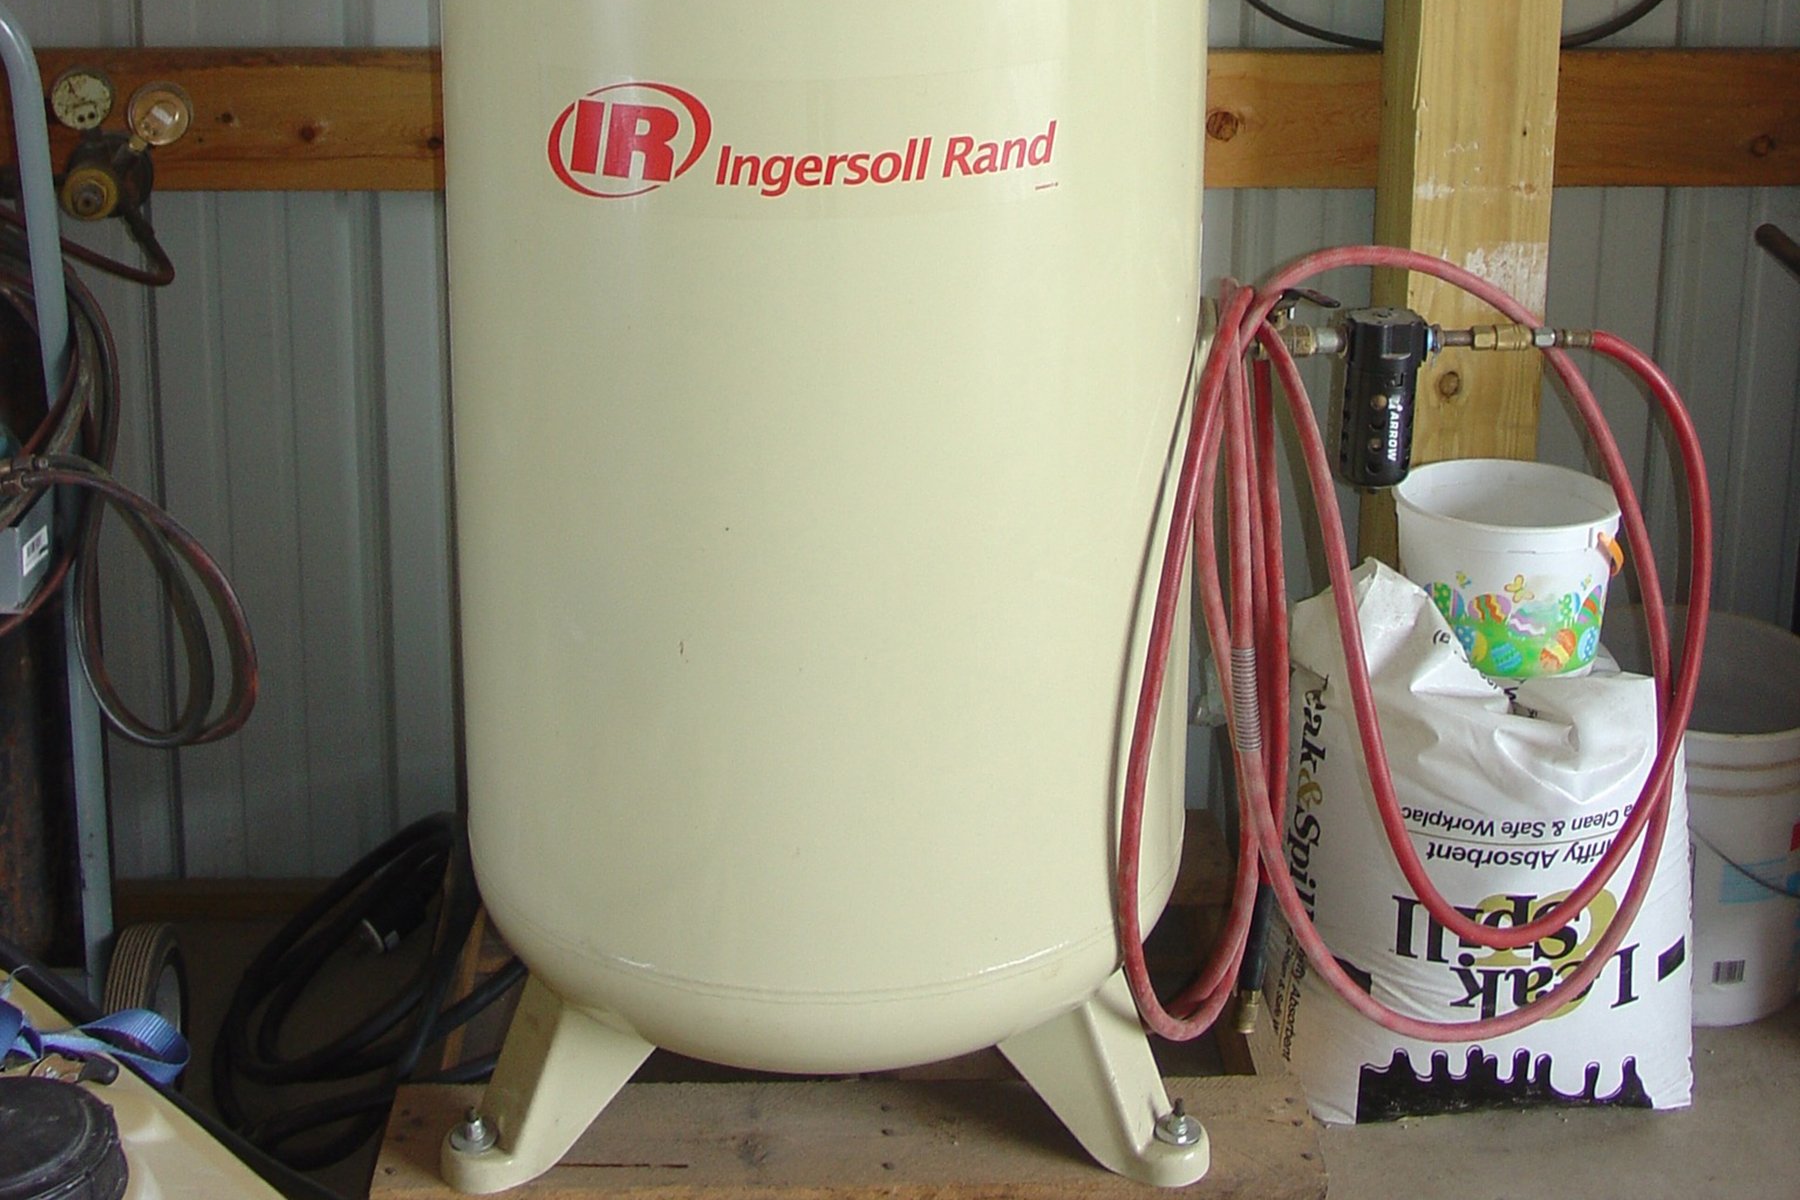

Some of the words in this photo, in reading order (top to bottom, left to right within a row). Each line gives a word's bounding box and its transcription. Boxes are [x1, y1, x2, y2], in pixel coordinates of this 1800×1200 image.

[570, 99, 679, 183] IR
[715, 136, 933, 197] Ingersoll
[942, 120, 1058, 178] Rand
[1386, 410, 1400, 462] ARROW
[1401, 806, 1494, 837] Workplac
[1501, 819, 1546, 838] Safe
[1551, 820, 1566, 836] &
[1571, 809, 1619, 830] Clean
[1426, 841, 1560, 870] Absorbent
[1562, 839, 1612, 865] rifty
